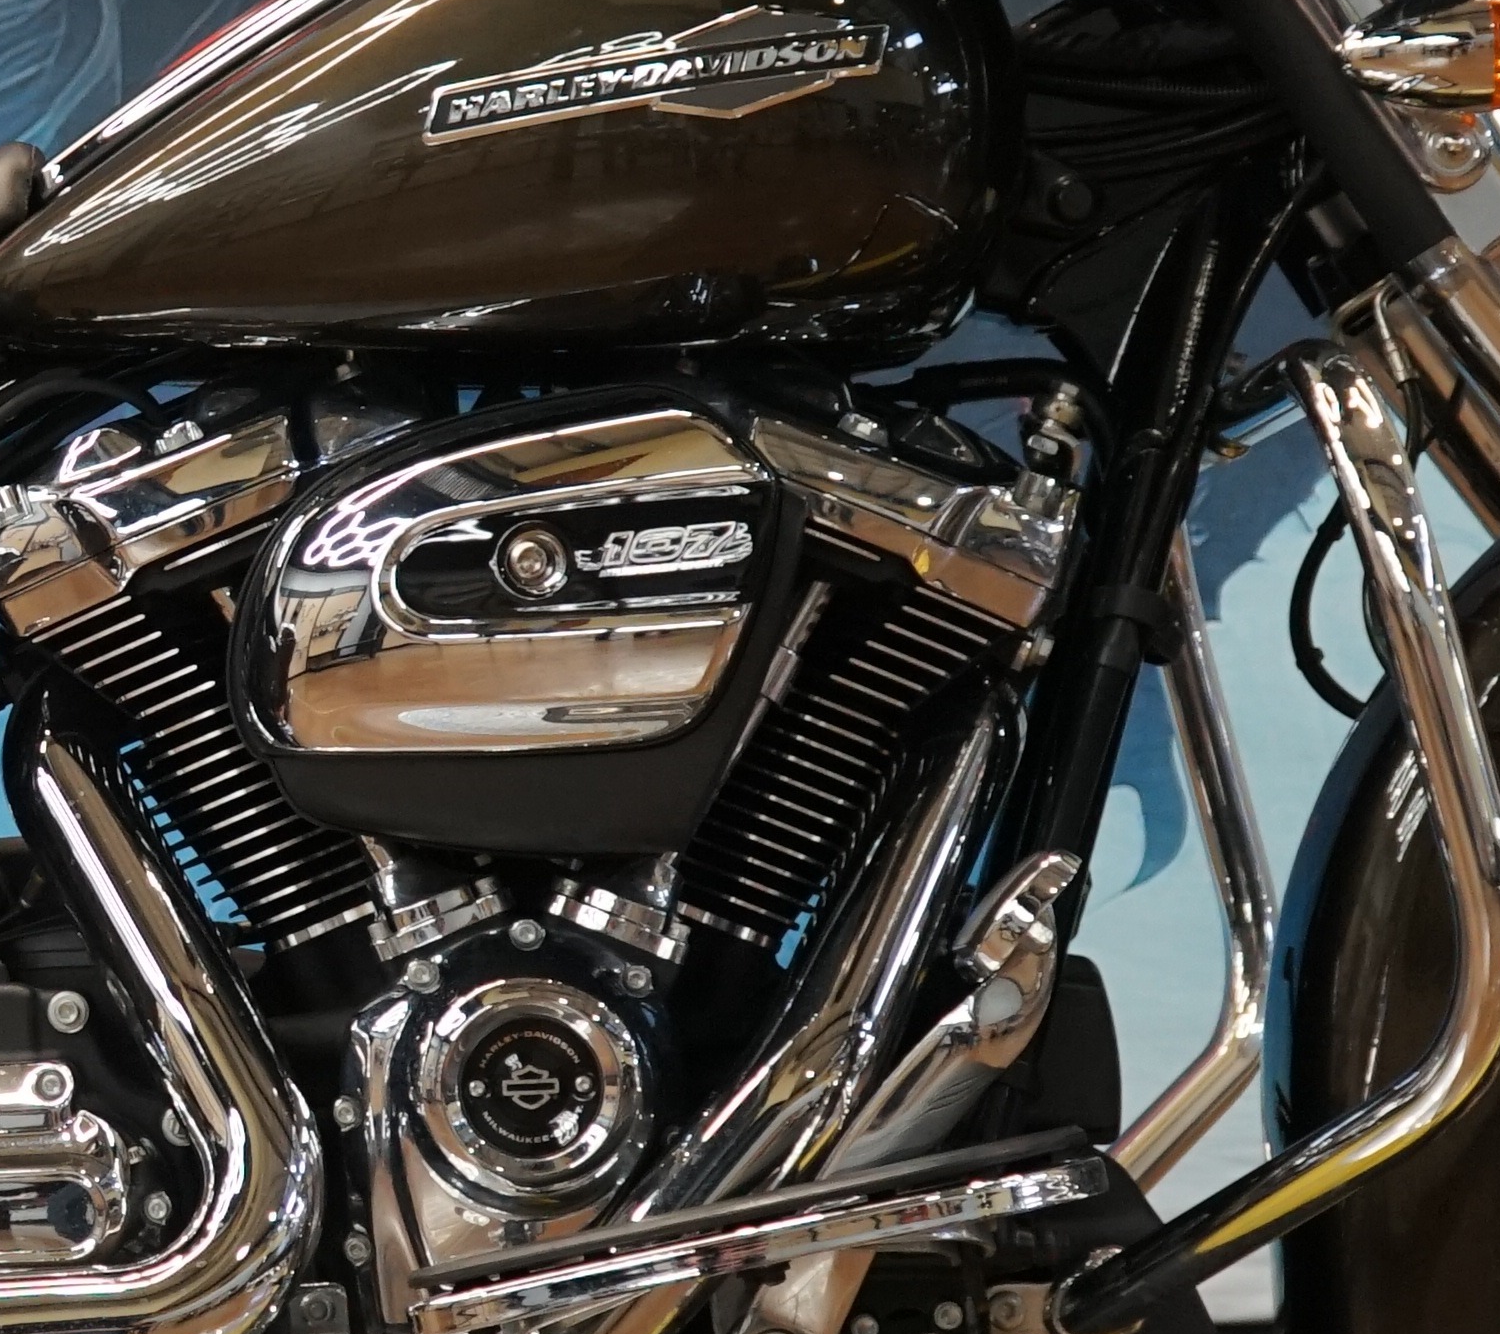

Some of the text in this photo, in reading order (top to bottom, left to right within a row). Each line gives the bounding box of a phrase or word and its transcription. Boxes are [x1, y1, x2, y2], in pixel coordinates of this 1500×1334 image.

[446, 34, 876, 125] HARLEY-DAVIDSON
[600, 520, 738, 567] 107
[479, 1030, 581, 1069] HARLEY-DAVIDSON
